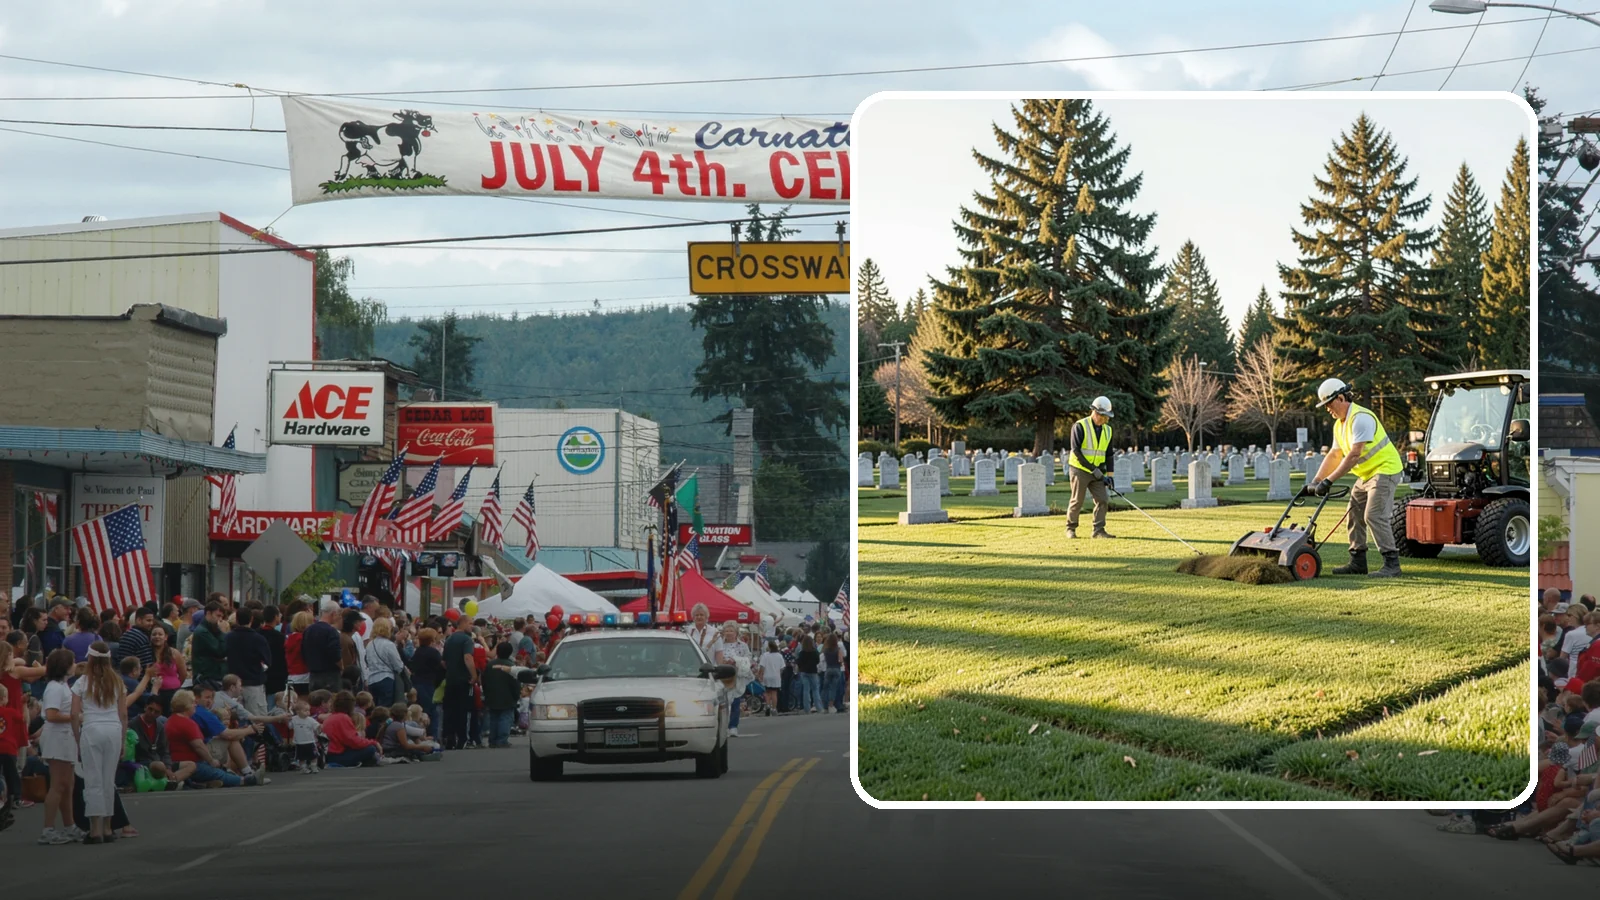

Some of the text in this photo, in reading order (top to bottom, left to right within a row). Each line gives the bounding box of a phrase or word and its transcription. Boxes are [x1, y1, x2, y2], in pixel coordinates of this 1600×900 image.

[481, 140, 605, 193] JULY
[632, 150, 746, 198] 4th.
[283, 380, 373, 420] ACE
[405, 409, 485, 422] CEDAR LOG
[283, 421, 371, 436] Hardware
[416, 428, 477, 447] Coca-Cola
[83, 485, 155, 495] St. Vincent de Paul
[688, 526, 741, 535] CRNATION
[699, 535, 730, 543] GLASS
